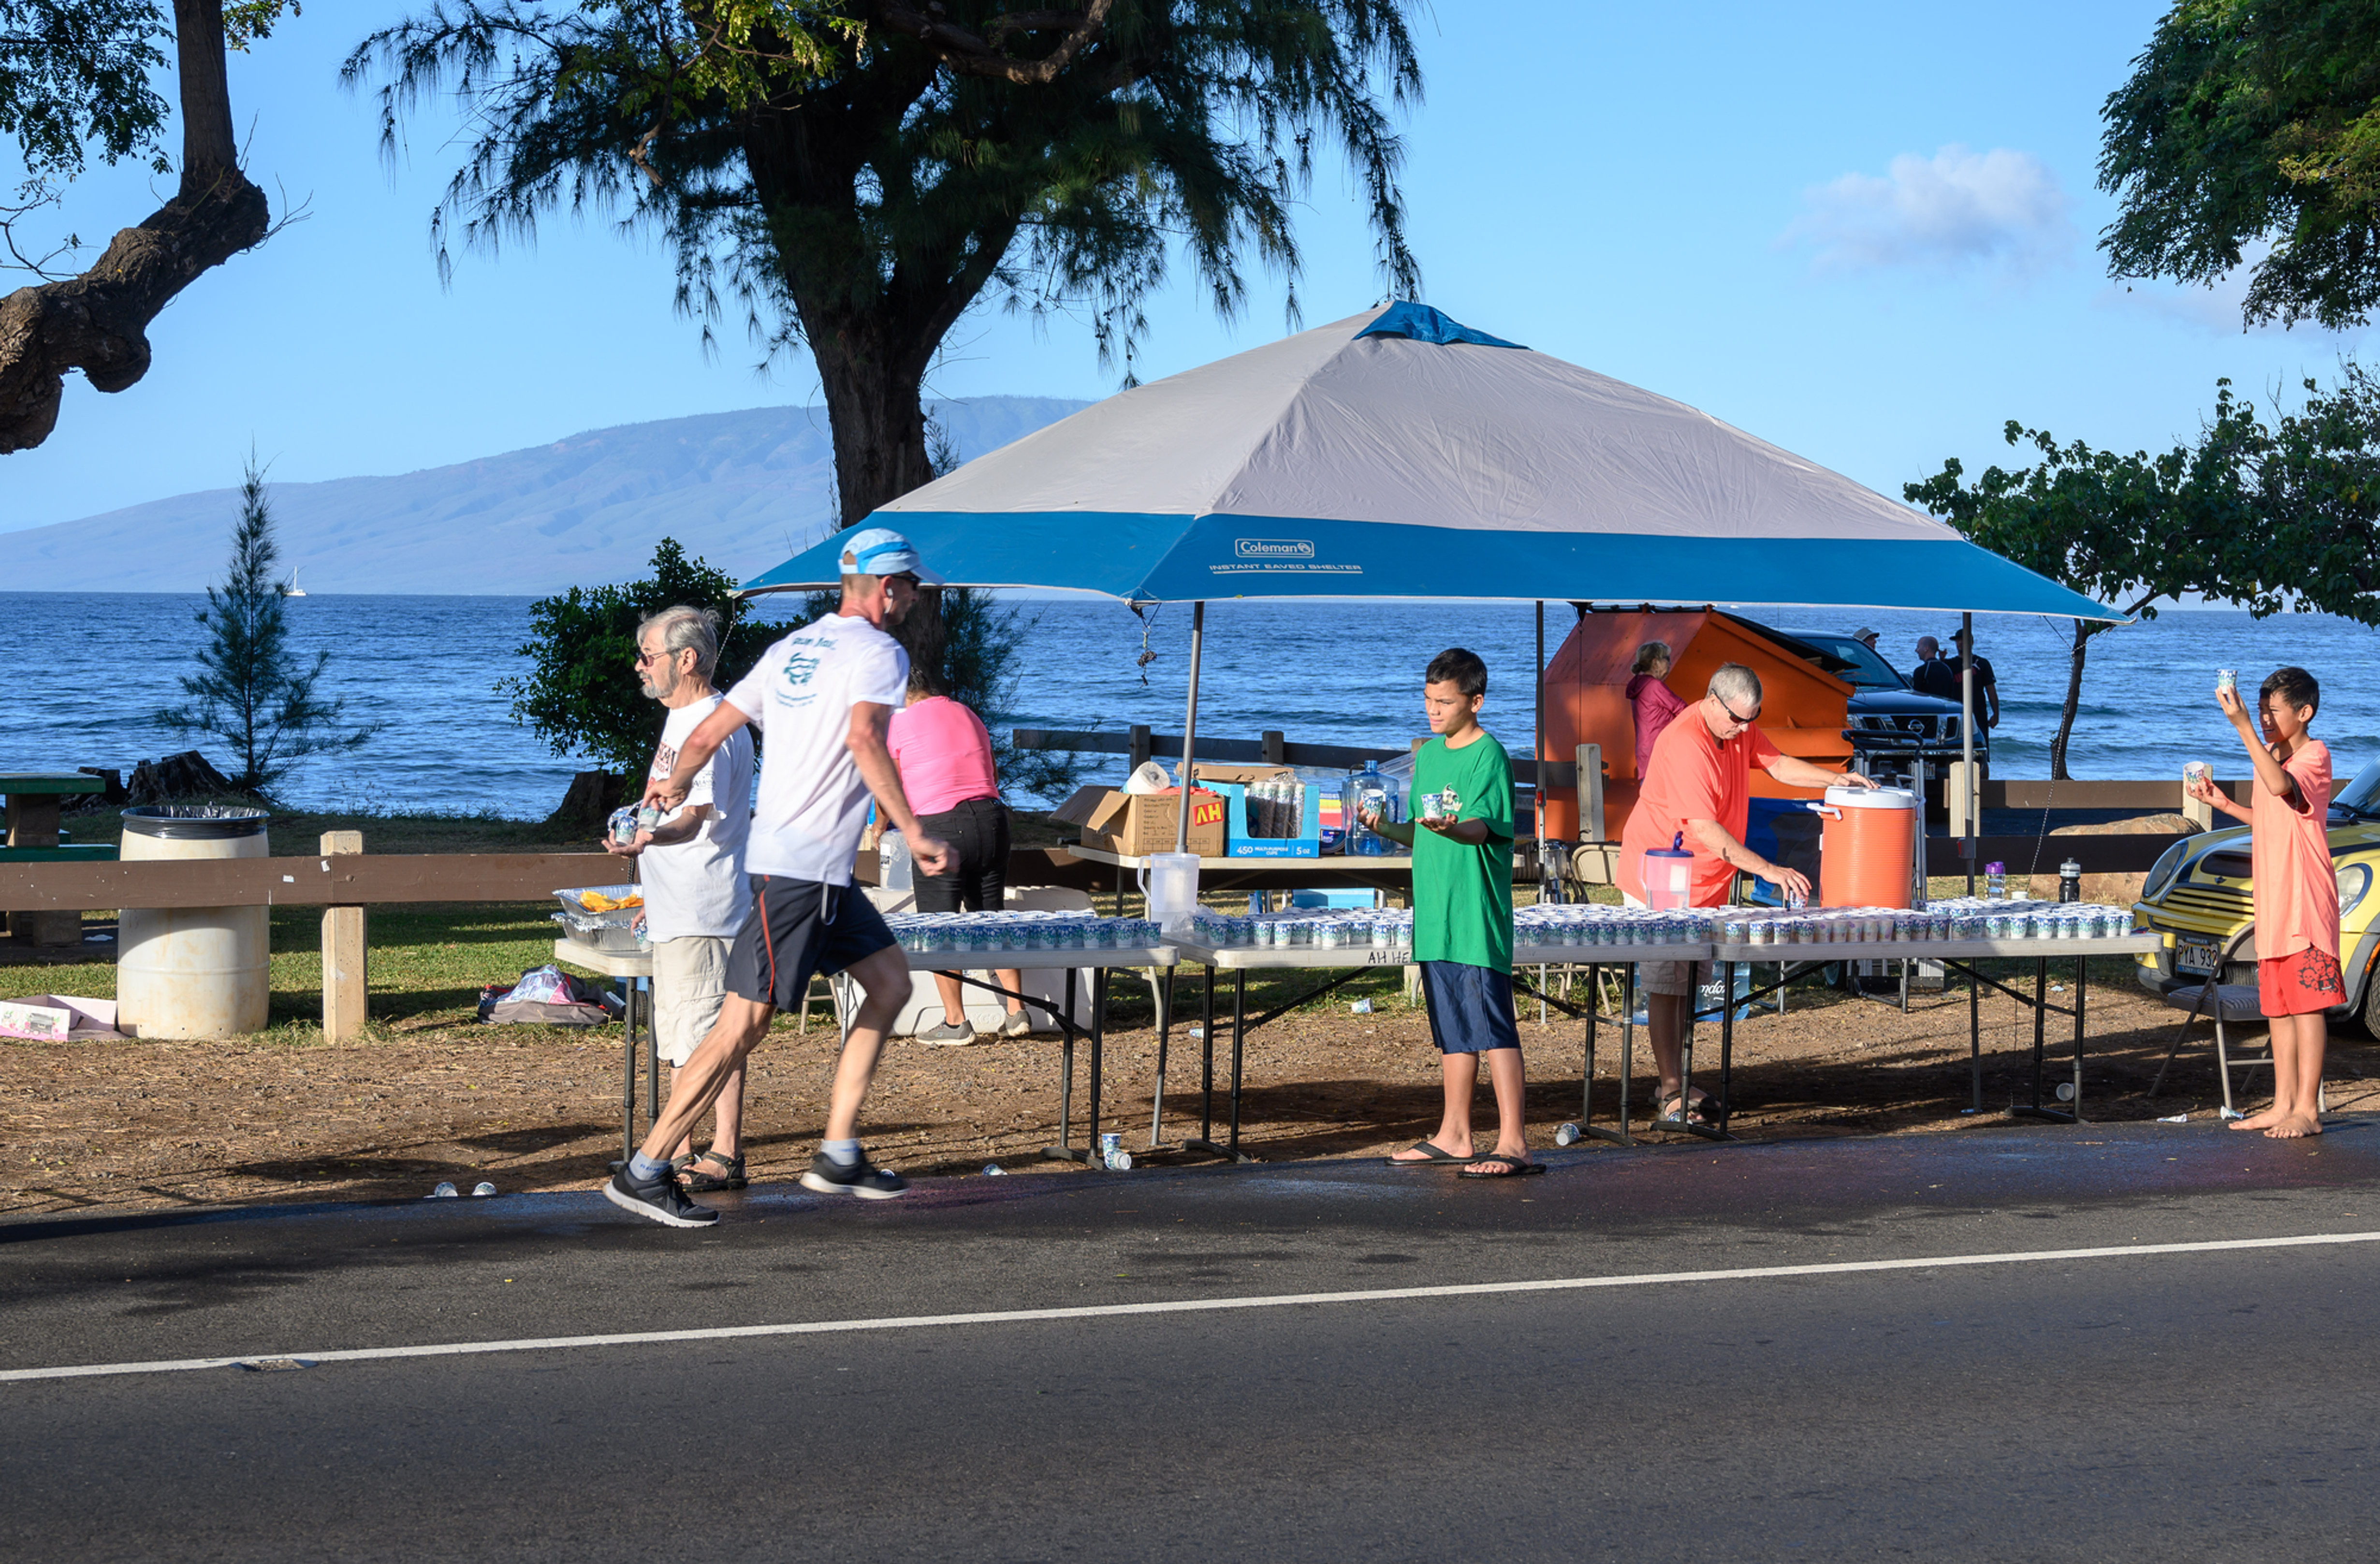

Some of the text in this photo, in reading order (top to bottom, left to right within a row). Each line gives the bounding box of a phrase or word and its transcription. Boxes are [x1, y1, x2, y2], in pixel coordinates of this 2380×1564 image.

[1240, 541, 1298, 554] Coleman
[1237, 846, 1253, 855] 450
[1296, 847, 1301, 855] 5
[1368, 951, 1387, 964] AH
[2200, 948, 2218, 967] 932
